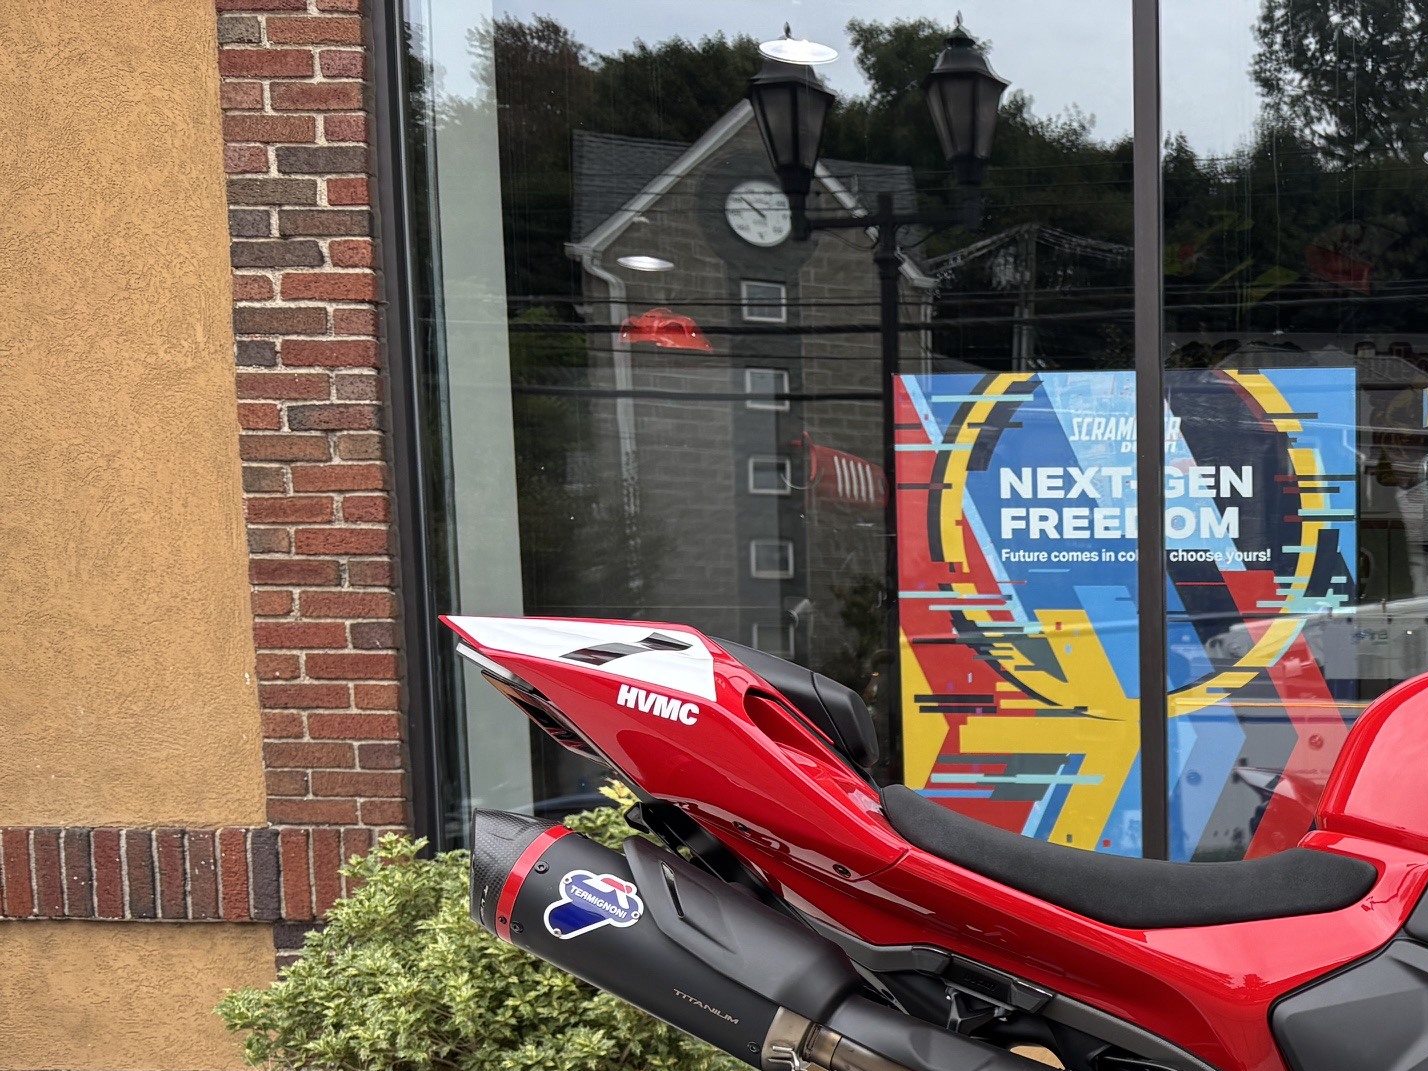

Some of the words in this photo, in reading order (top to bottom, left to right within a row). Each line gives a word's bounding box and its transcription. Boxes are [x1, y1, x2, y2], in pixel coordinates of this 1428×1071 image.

[1069, 417, 1182, 441] SCRAMR
[1001, 548, 1047, 562] Future
[1050, 551, 1098, 562] comes
[1101, 549, 1115, 562] in
[1169, 549, 1222, 562] choose
[1225, 548, 1271, 565] yours!
[616, 684, 700, 726] HVMC
[570, 883, 628, 920] TERMIGNONI
[673, 987, 740, 1025] TITANIUM
